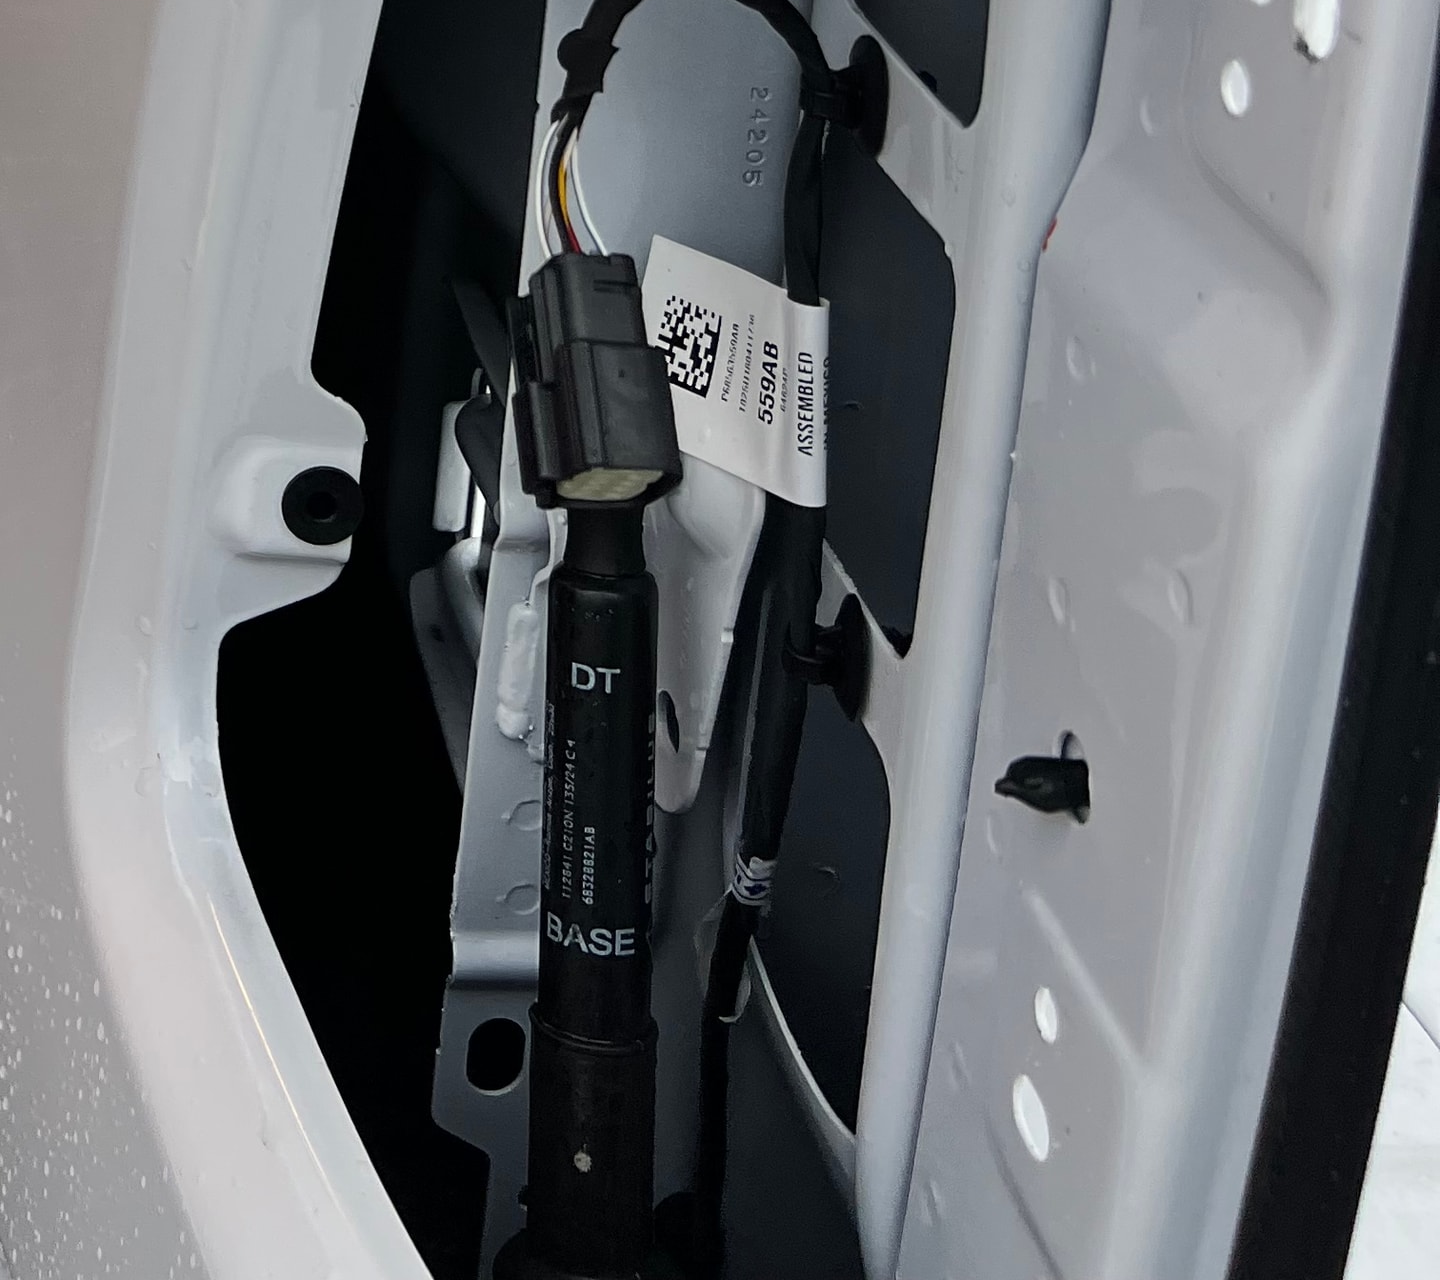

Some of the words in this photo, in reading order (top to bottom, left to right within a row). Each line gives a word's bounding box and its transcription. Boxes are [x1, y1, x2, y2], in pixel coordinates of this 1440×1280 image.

[758, 341, 779, 425] 559AB
[798, 351, 814, 456] ASSEMBLED
[571, 661, 621, 694] DT
[582, 826, 596, 905] 68328821AB
[546, 911, 636, 956] BASE
